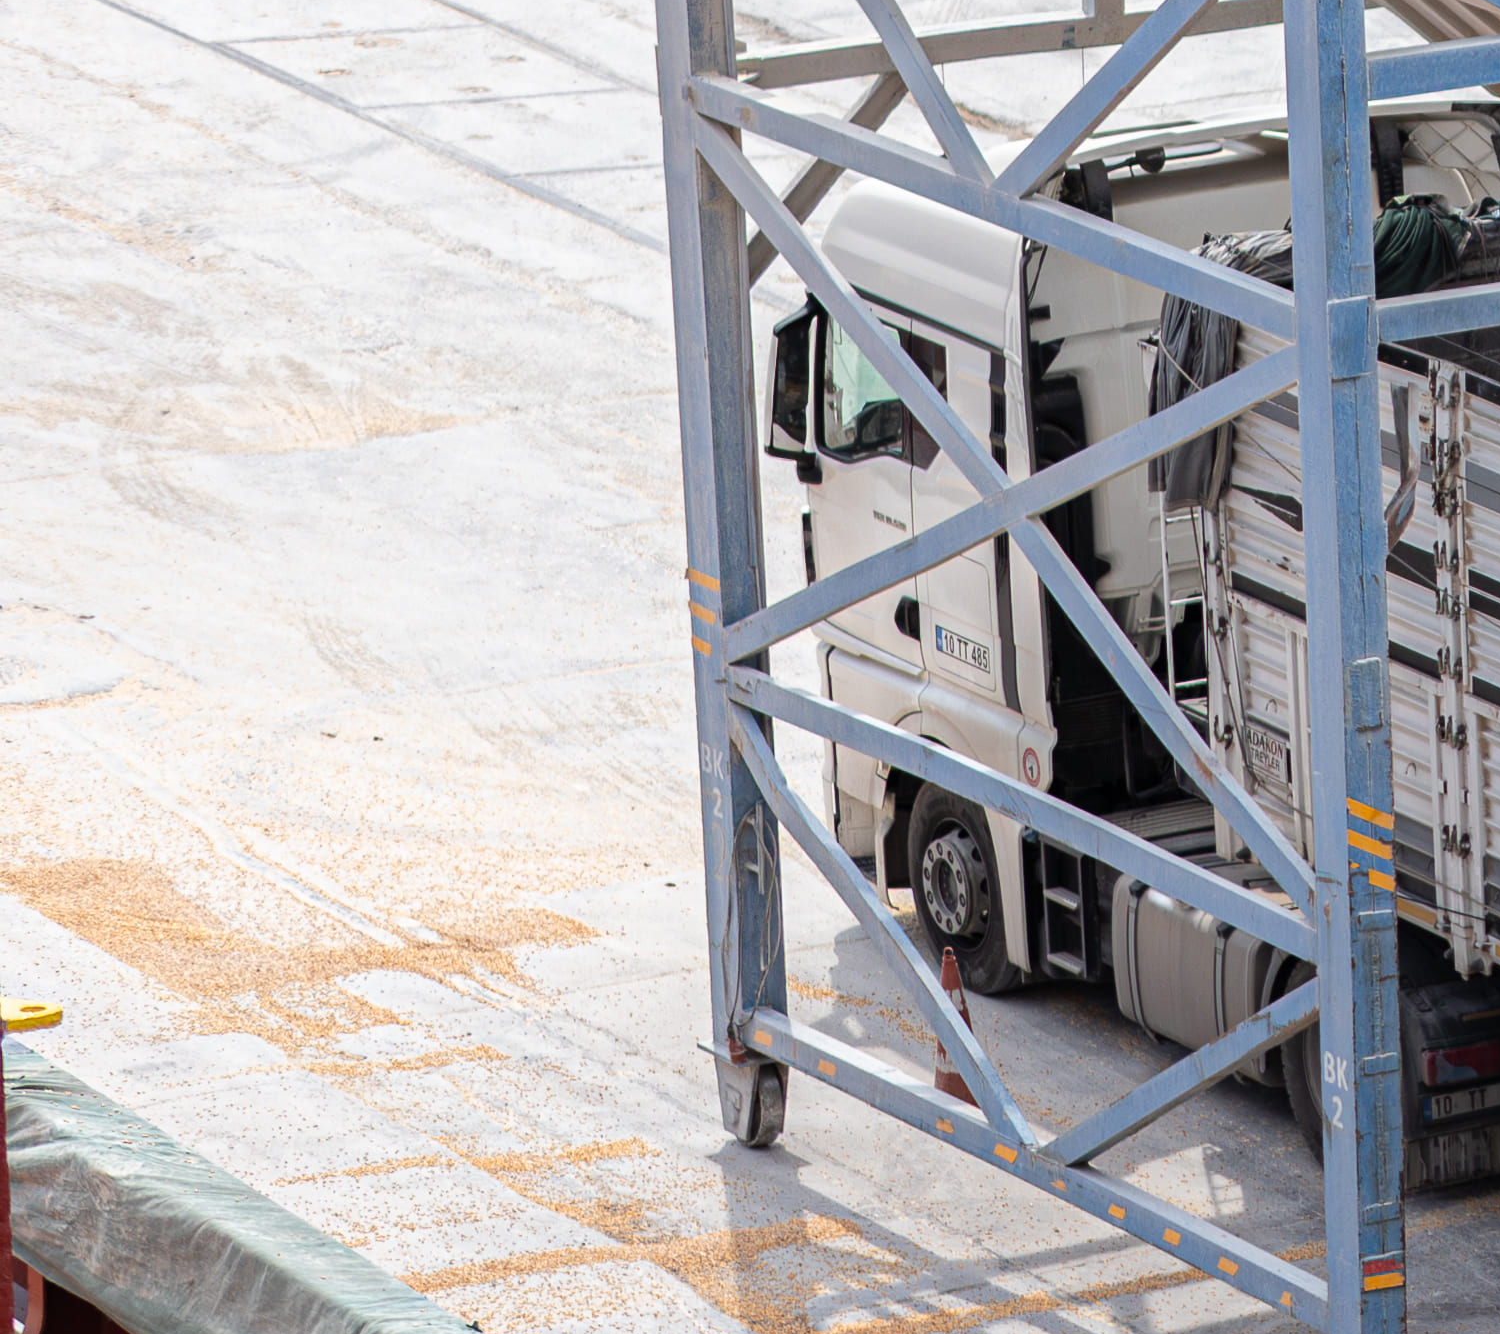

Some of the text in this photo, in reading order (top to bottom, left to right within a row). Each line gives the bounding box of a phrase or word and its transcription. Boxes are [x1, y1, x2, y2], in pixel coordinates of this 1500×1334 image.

[945, 632, 988, 669] 10 TT 485
[701, 741, 724, 779] BK
[713, 787, 724, 819] 2
[1323, 1050, 1349, 1091] BK
[1332, 1095, 1344, 1129] 2
[1435, 1095, 1452, 1117] 10
[1468, 1089, 1487, 1110] TT
